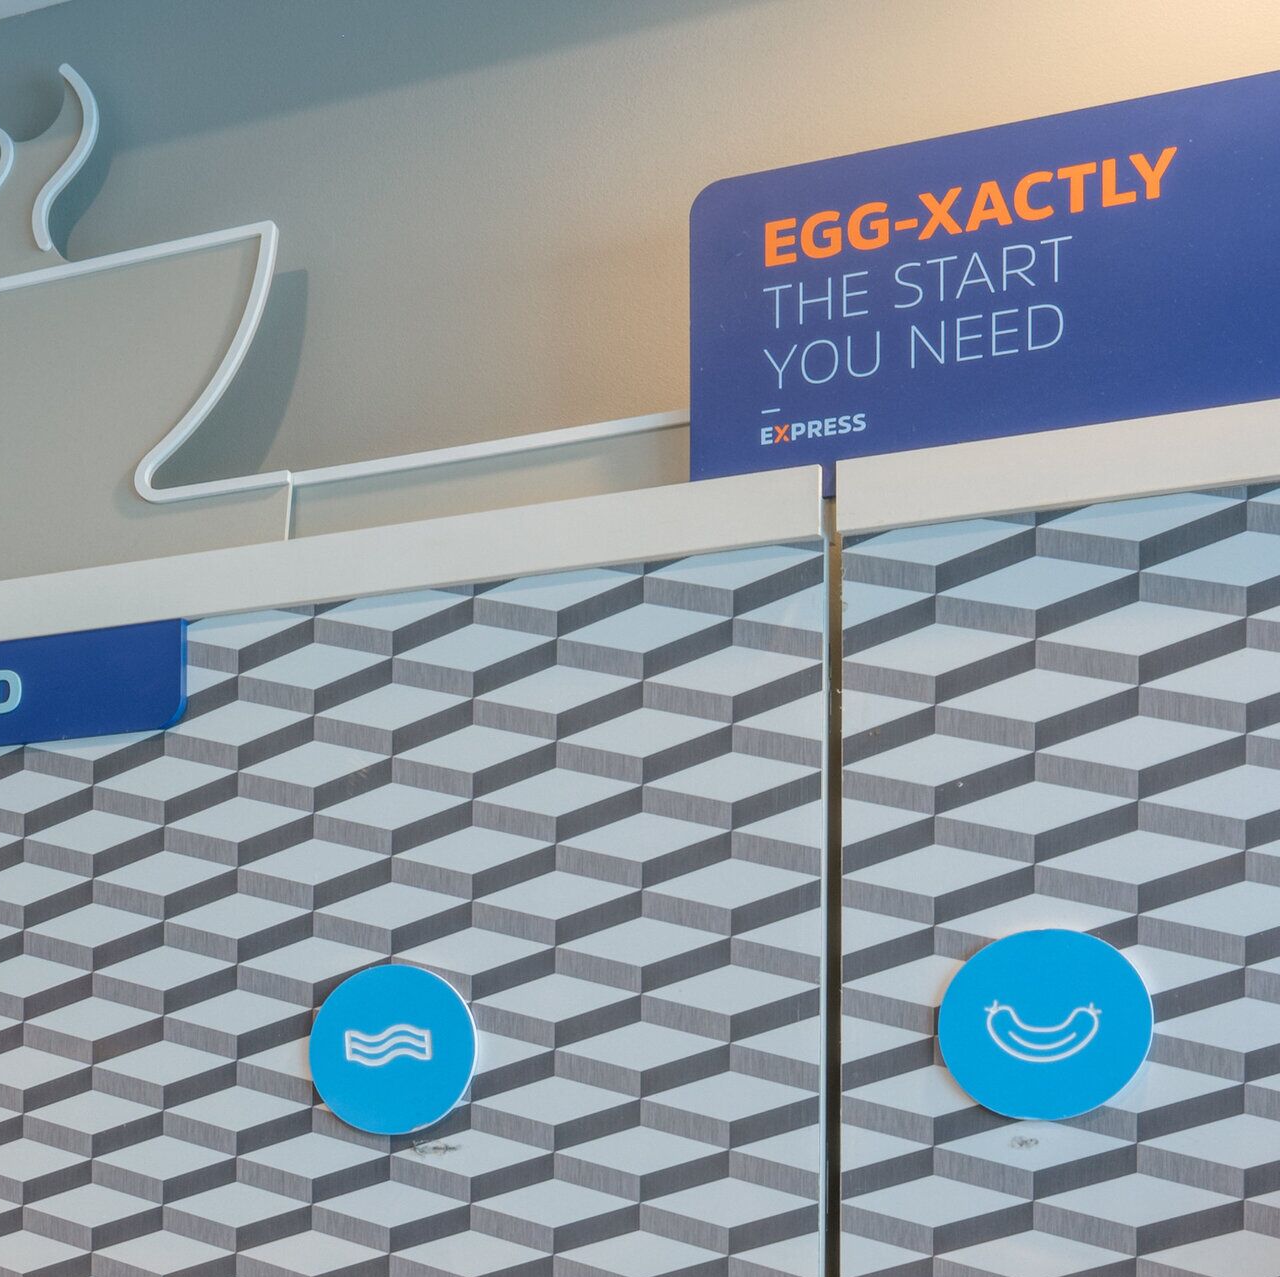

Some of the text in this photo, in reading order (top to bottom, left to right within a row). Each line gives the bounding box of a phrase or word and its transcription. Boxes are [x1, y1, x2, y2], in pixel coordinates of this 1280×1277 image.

[764, 146, 1177, 267] EGG-XACTLY
[763, 236, 1073, 329] THE START
[763, 304, 1065, 389] YOU NEED
[760, 413, 867, 446] EXPRESS
